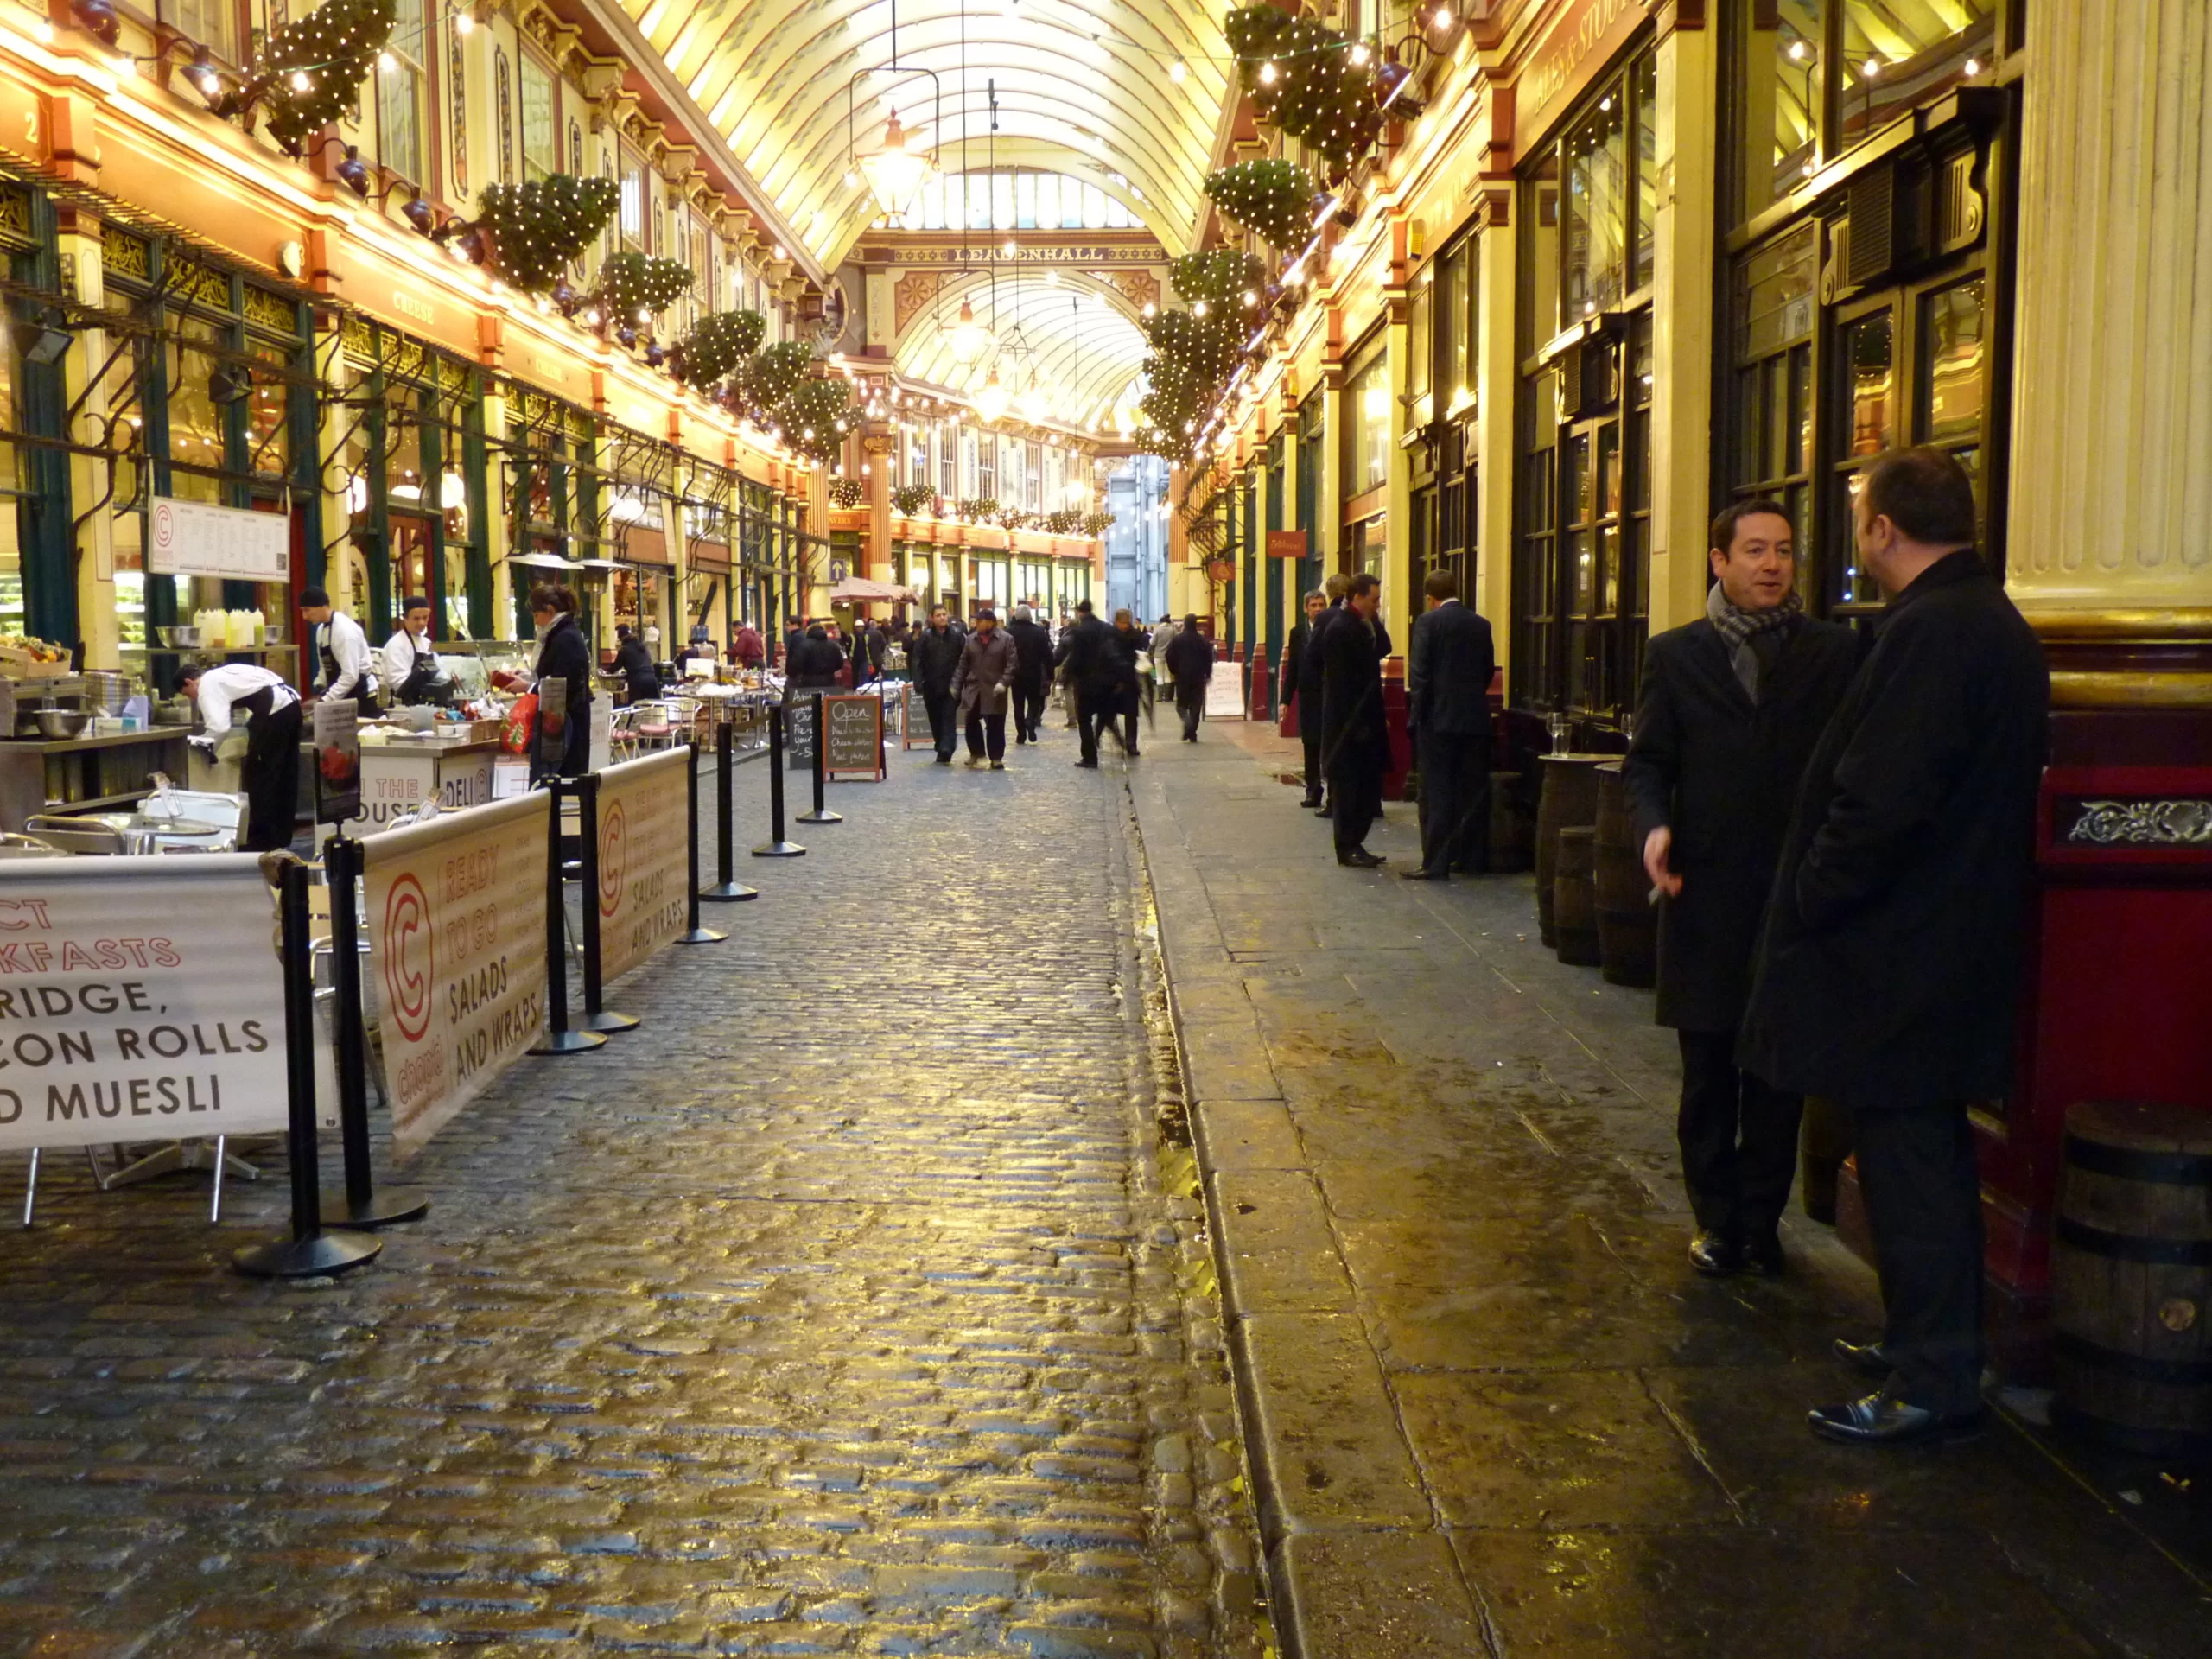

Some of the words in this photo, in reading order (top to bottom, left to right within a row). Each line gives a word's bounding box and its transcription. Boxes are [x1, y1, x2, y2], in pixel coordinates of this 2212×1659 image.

[24, 111, 38, 144] 2
[954, 248, 1103, 261] LEADENHALL
[393, 290, 434, 325] CHEESE
[832, 702, 870, 728] Open
[376, 778, 419, 798] THE
[446, 777, 474, 807] DELI
[446, 844, 499, 904] READY
[632, 868, 664, 912] SALADS
[446, 916, 467, 964] TO
[473, 902, 498, 951] GO
[632, 918, 651, 955] AND
[653, 899, 683, 936] WRAPS
[450, 956, 507, 1025] SALADS
[0, 1030, 95, 1071] ON
[115, 1020, 268, 1061] ROLLS
[457, 1027, 487, 1086] AND
[492, 992, 537, 1056] WRAPS
[46, 1074, 221, 1122] MUESLI
